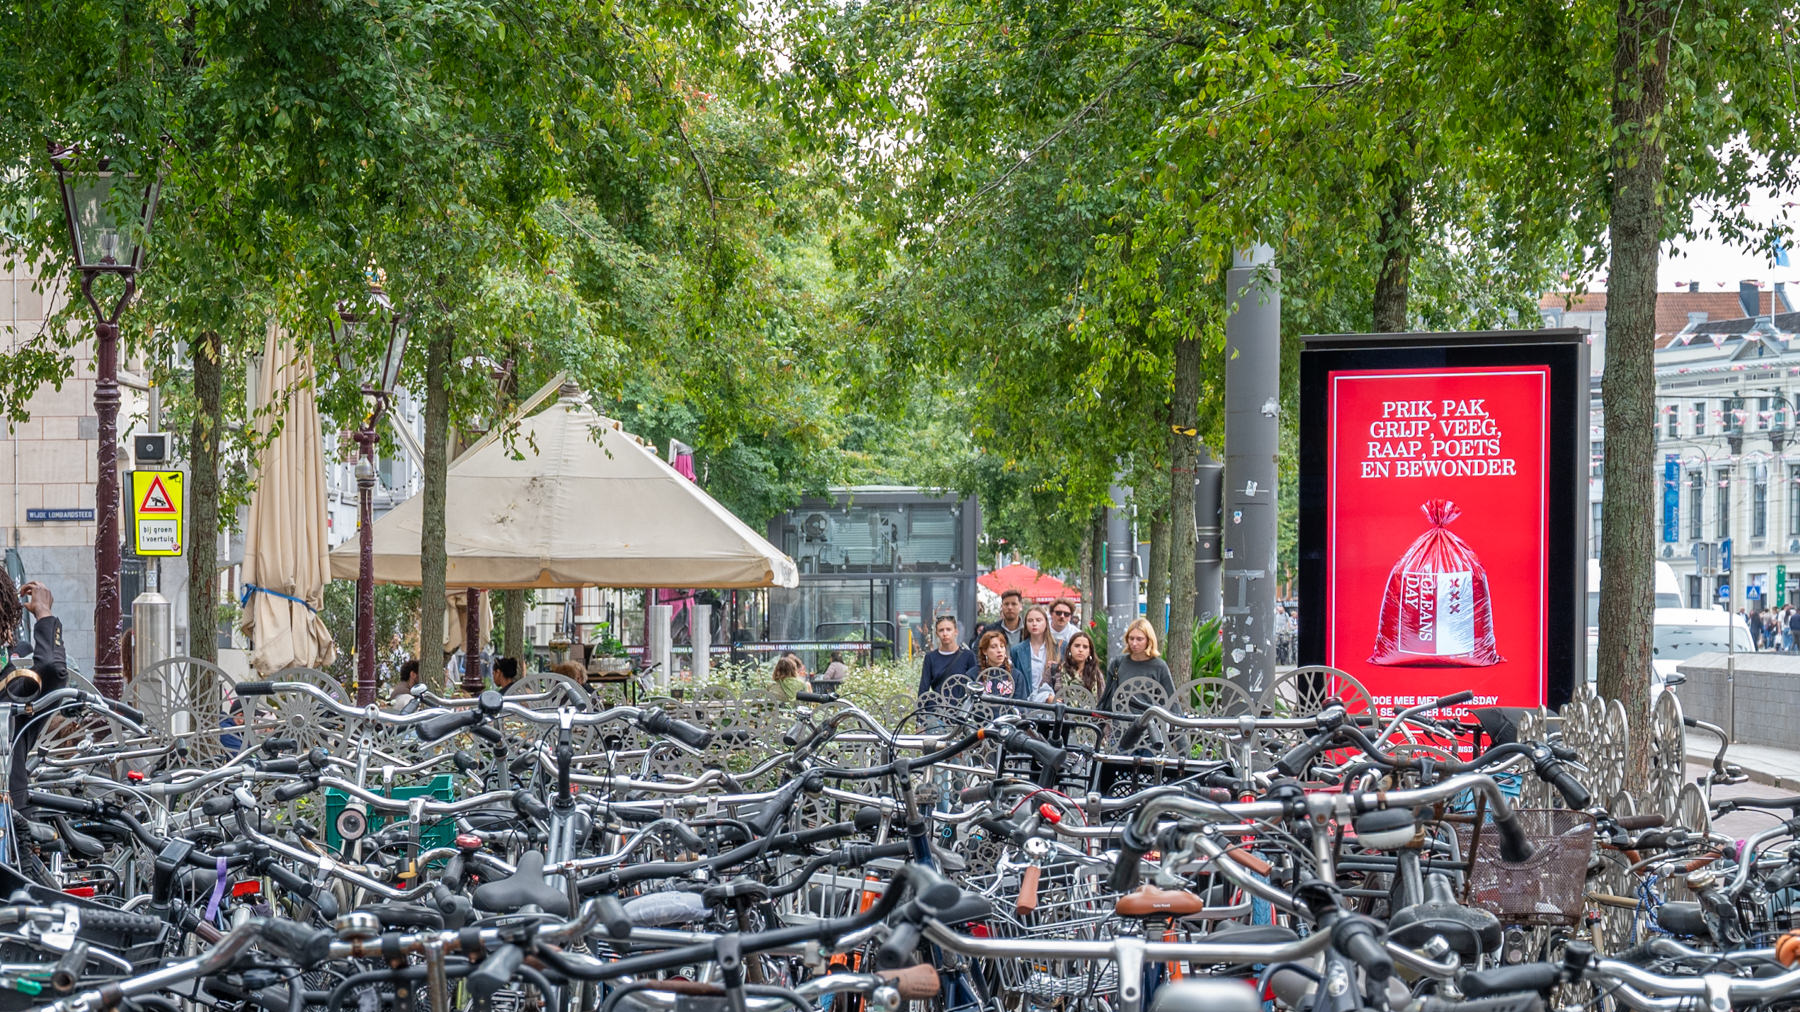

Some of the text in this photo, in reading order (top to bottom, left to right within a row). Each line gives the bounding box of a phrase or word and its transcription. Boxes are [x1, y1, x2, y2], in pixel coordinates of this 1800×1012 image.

[1382, 399, 1489, 420] PRIK, PAK,
[1370, 418, 1501, 440] GRIJP, VEEG,
[1367, 439, 1501, 460] RAAP, POETS
[1361, 458, 1517, 478] EN BEWONDER
[143, 526, 172, 535] bij groen
[146, 536, 174, 544] voertuig
[1405, 577, 1420, 609] DAY
[1373, 696, 1392, 705] DOE
[1394, 696, 1414, 705] MEE
[1417, 696, 1439, 705] MET
